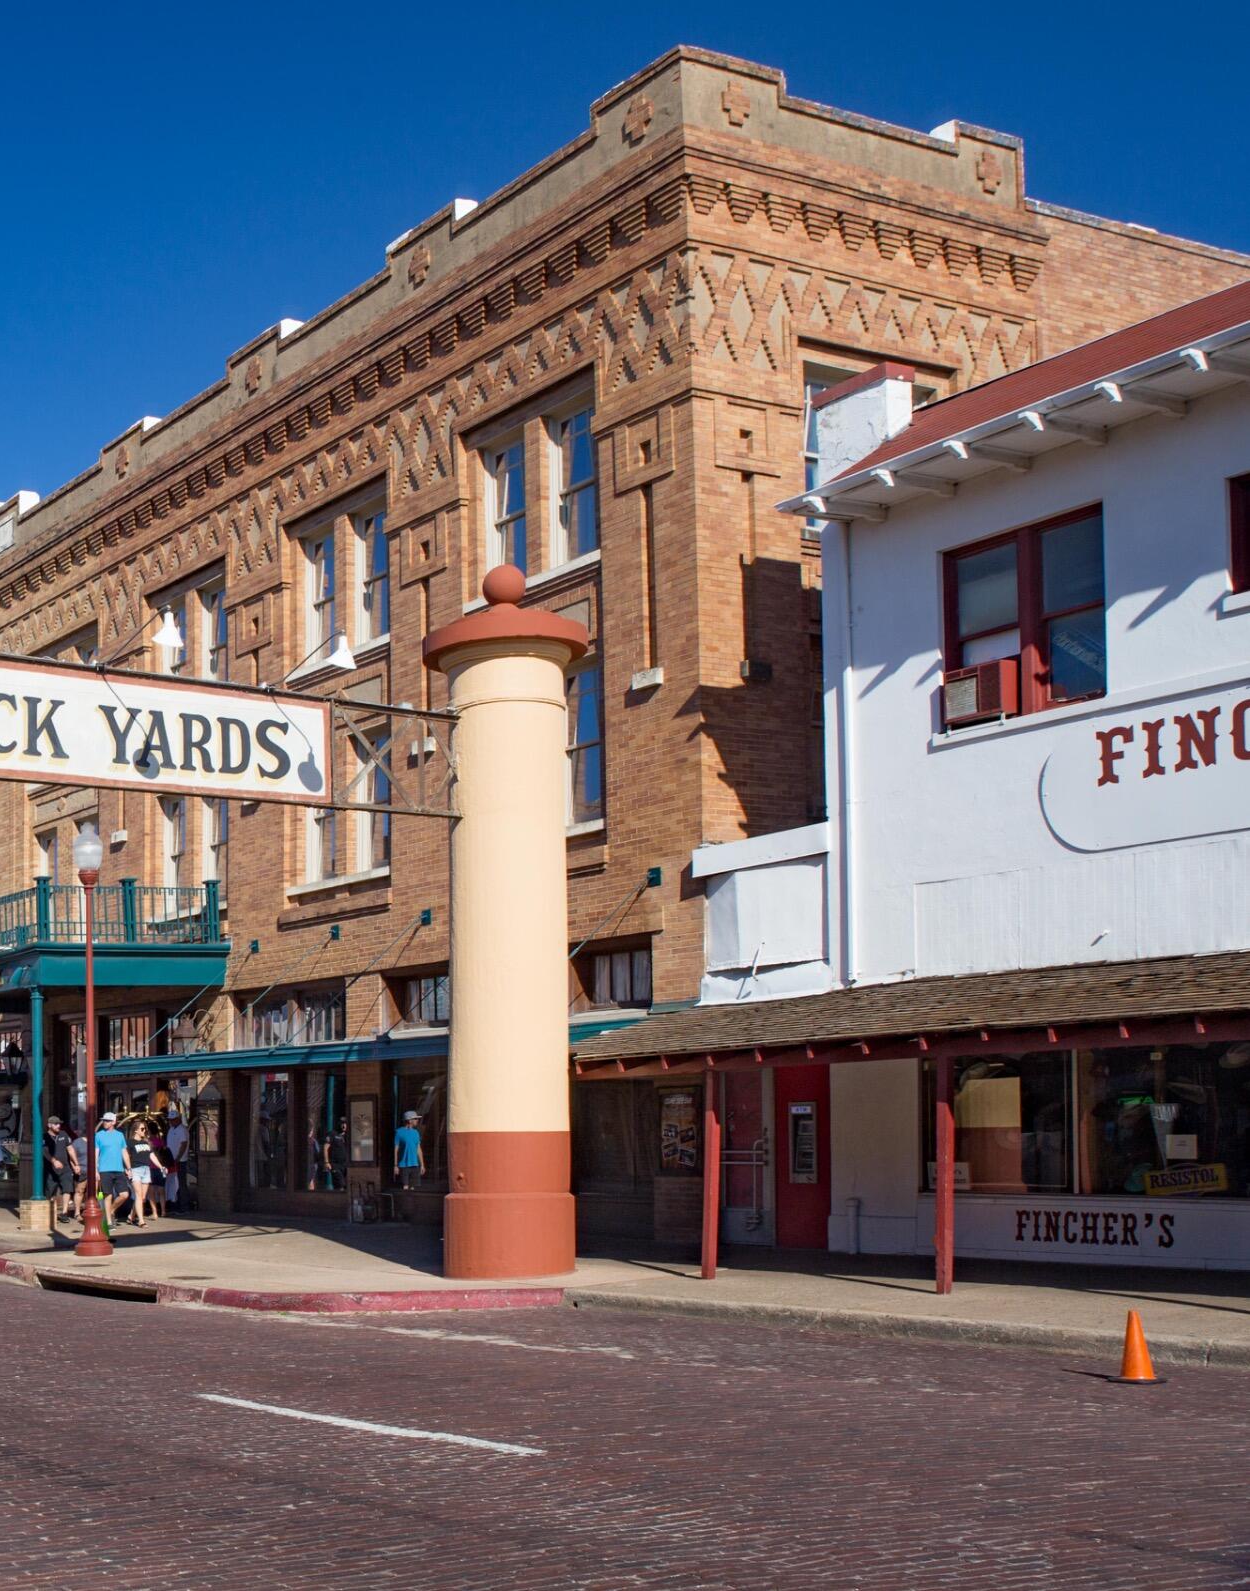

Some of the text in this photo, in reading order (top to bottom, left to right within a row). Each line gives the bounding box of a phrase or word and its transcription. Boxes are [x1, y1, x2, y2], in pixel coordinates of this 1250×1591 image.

[97, 703, 292, 780] YARDS
[1149, 1167, 1219, 1189] RESISTOL
[1015, 1209, 1175, 1249] FINCHER'S
